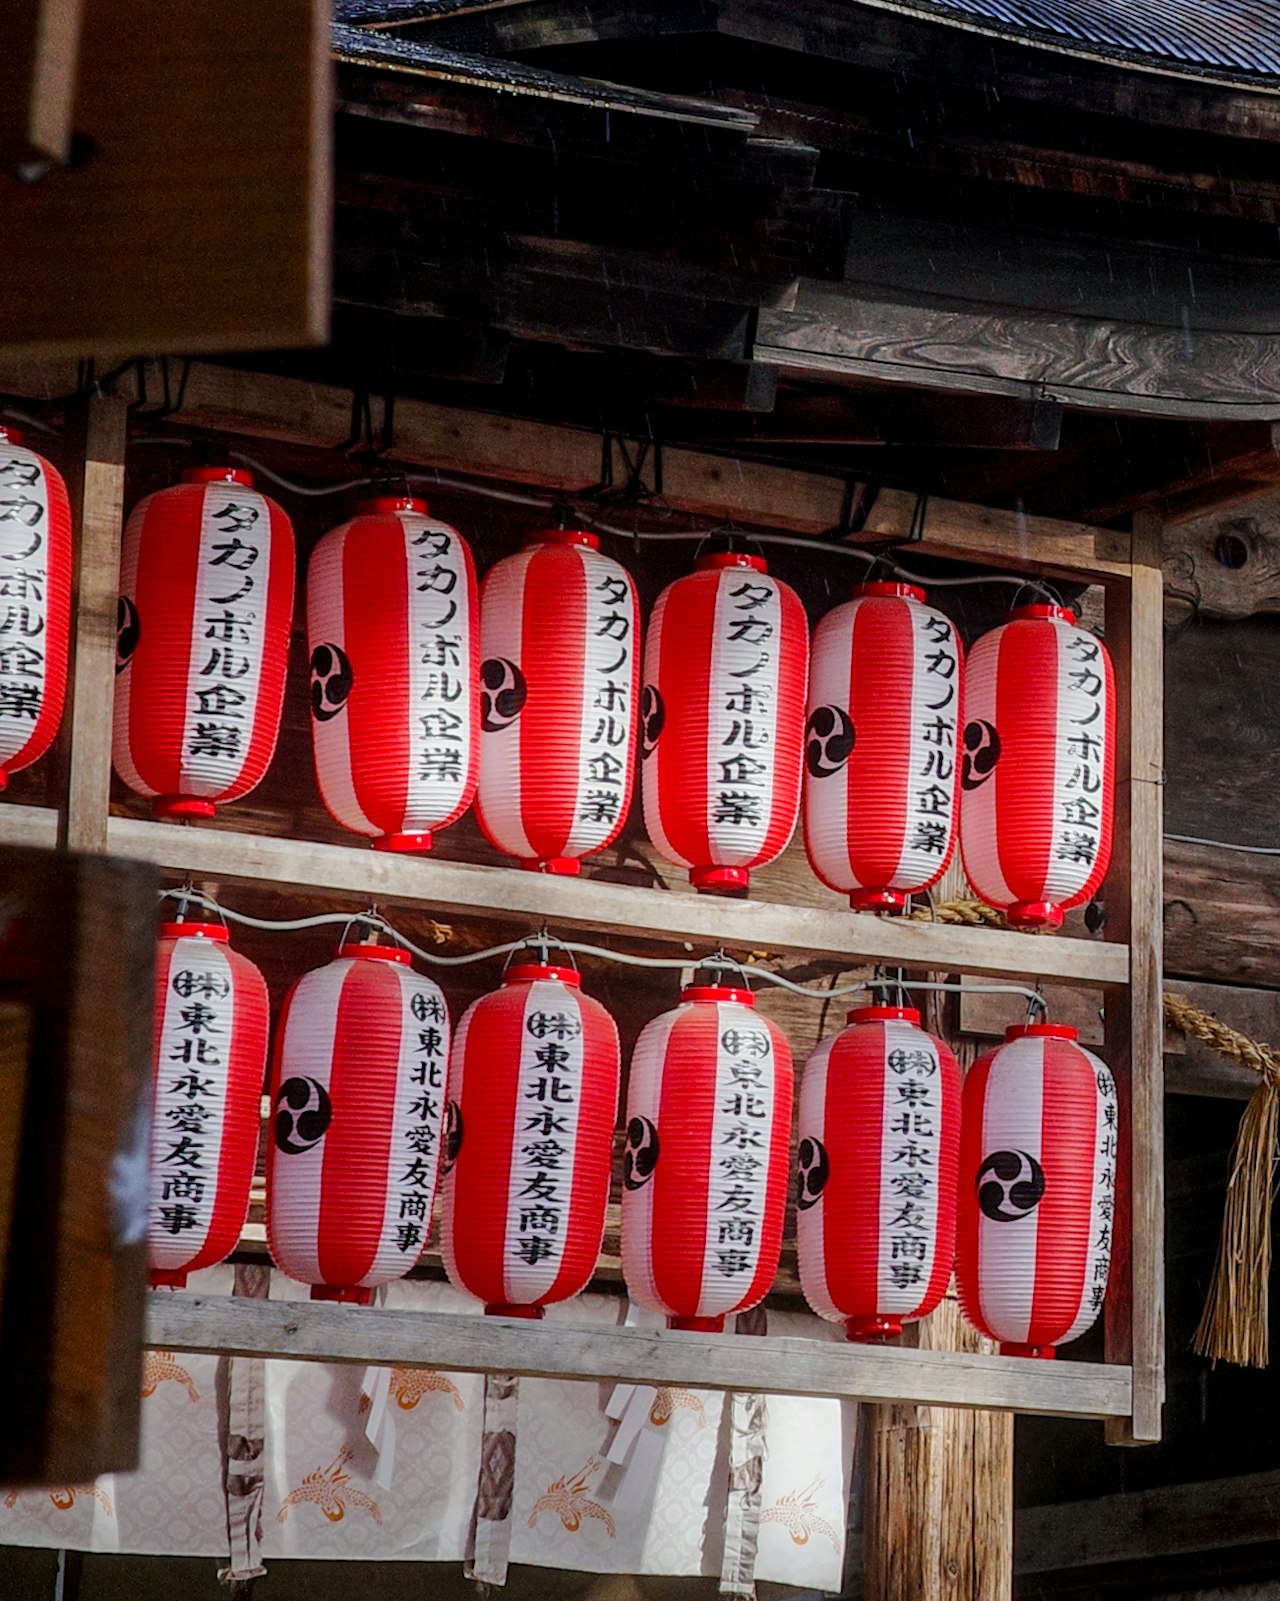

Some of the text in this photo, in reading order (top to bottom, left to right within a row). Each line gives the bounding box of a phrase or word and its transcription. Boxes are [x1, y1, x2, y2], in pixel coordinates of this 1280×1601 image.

[190, 502, 260, 760] タカノボル企業
[411, 530, 465, 783] タカノボル企業
[579, 574, 630, 826] タカノボル企業
[714, 582, 774, 828] タカノボル企業
[911, 615, 959, 857] タカノボル企業
[1056, 636, 1104, 867] タカノボル企業
